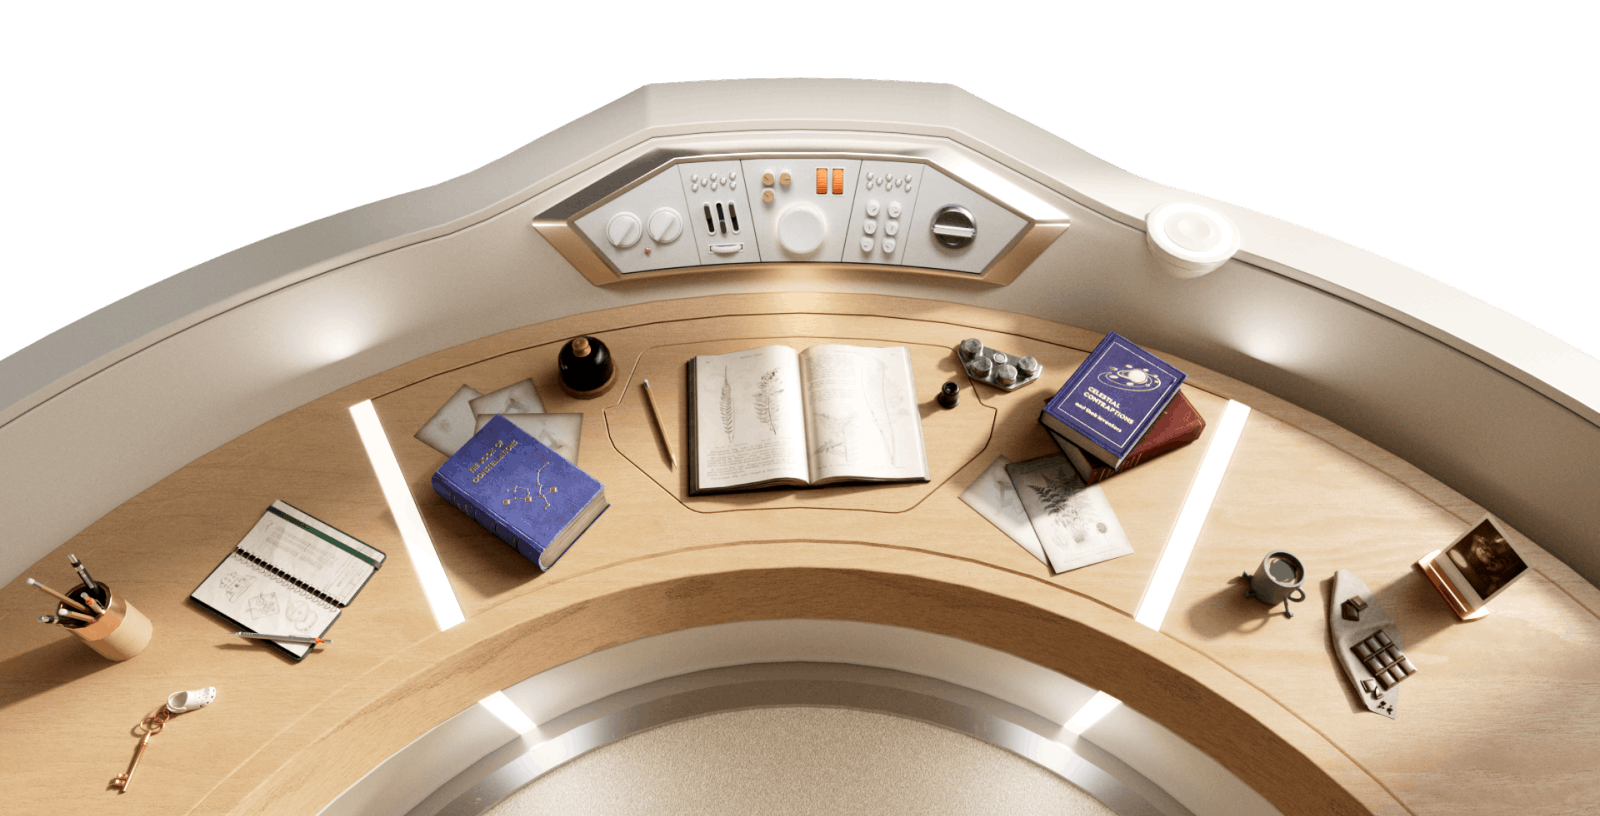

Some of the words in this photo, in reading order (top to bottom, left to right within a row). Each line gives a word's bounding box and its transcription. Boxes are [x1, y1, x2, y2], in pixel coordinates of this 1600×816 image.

[1083, 391, 1134, 425] CONTRAPTIONS
[1088, 386, 1120, 409] CELESTIAL
[1075, 402, 1086, 410] and
[1085, 407, 1098, 418] their
[1097, 415, 1122, 433] inventors
[468, 462, 480, 473] THE
[478, 448, 496, 464] BOOK
[494, 440, 503, 449] OF
